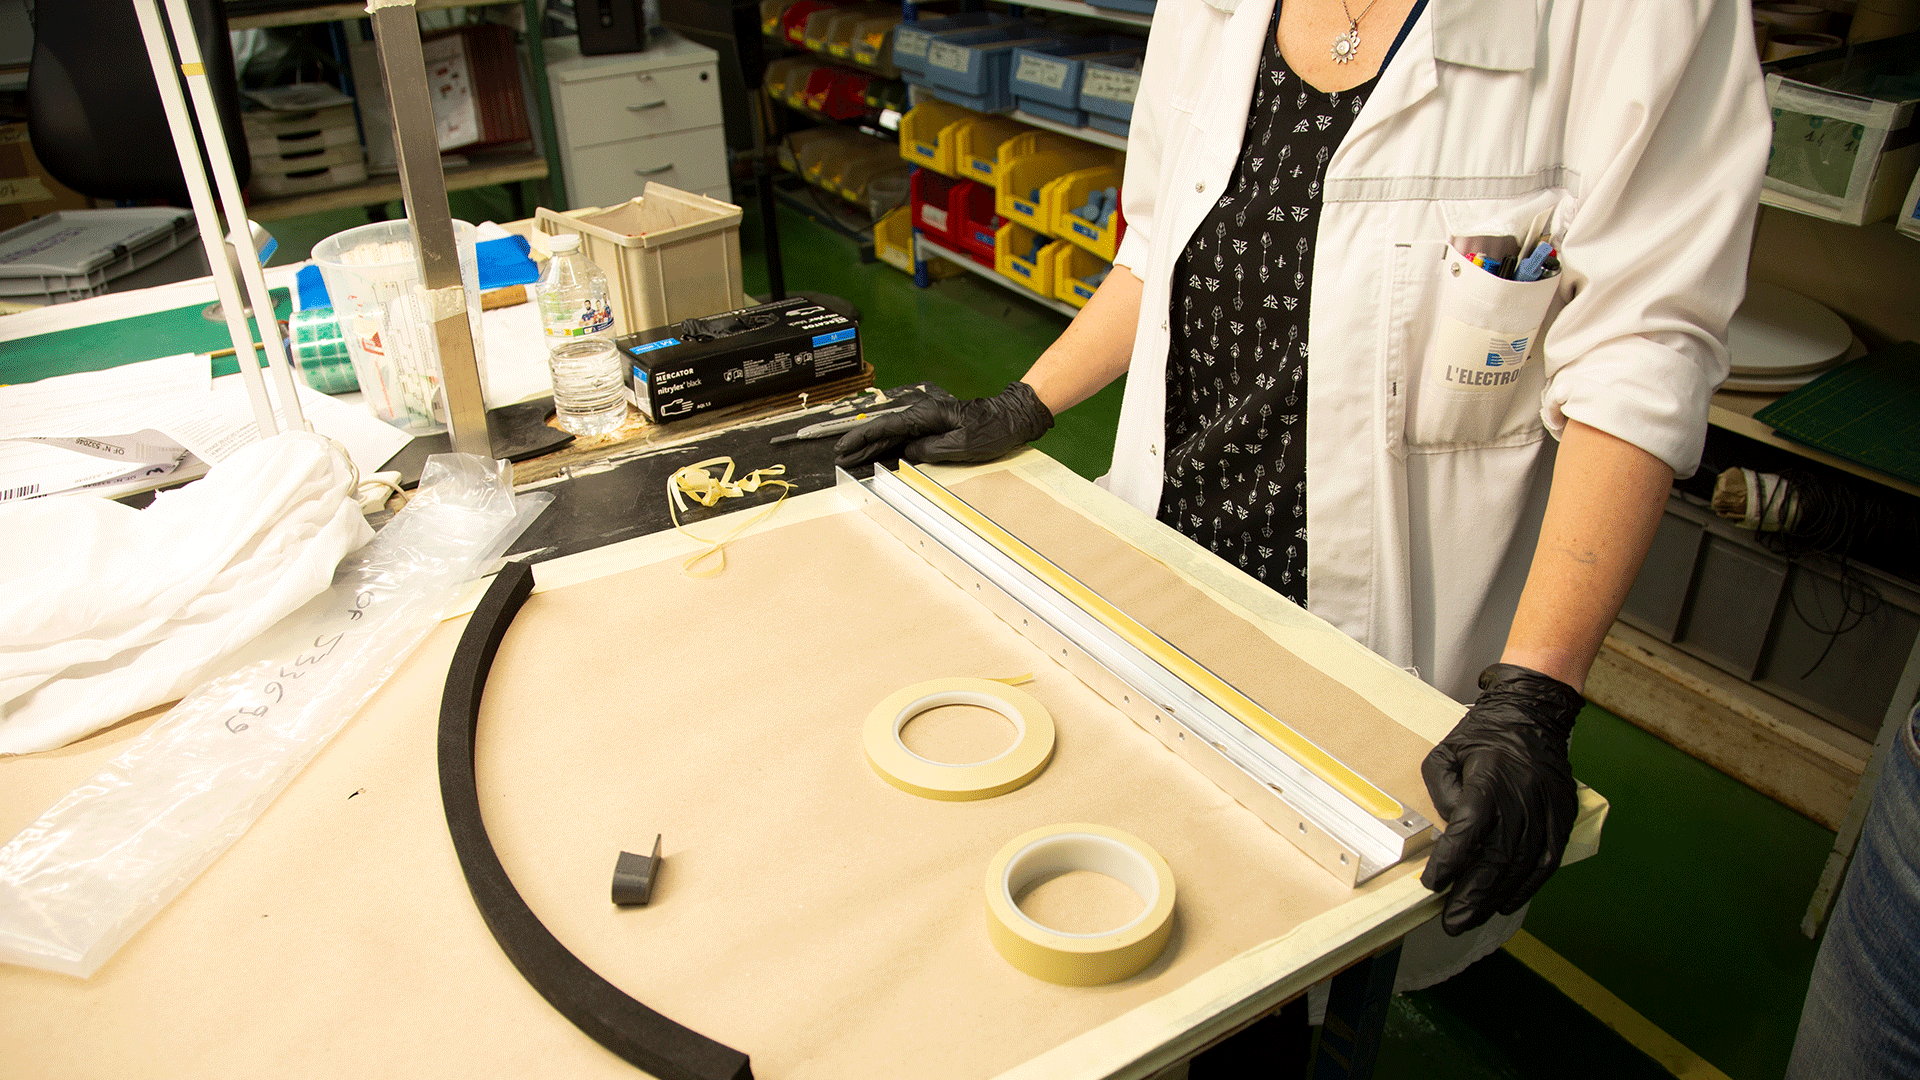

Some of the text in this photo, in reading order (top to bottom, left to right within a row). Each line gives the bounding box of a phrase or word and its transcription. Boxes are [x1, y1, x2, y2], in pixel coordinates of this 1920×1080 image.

[656, 367, 694, 383] MERCATOR
[1445, 364, 1524, 386] L'ELECTRO
[686, 378, 702, 389] black
[75, 438, 100, 450] 532046
[114, 447, 125, 455] OF
[347, 590, 375, 621] OF
